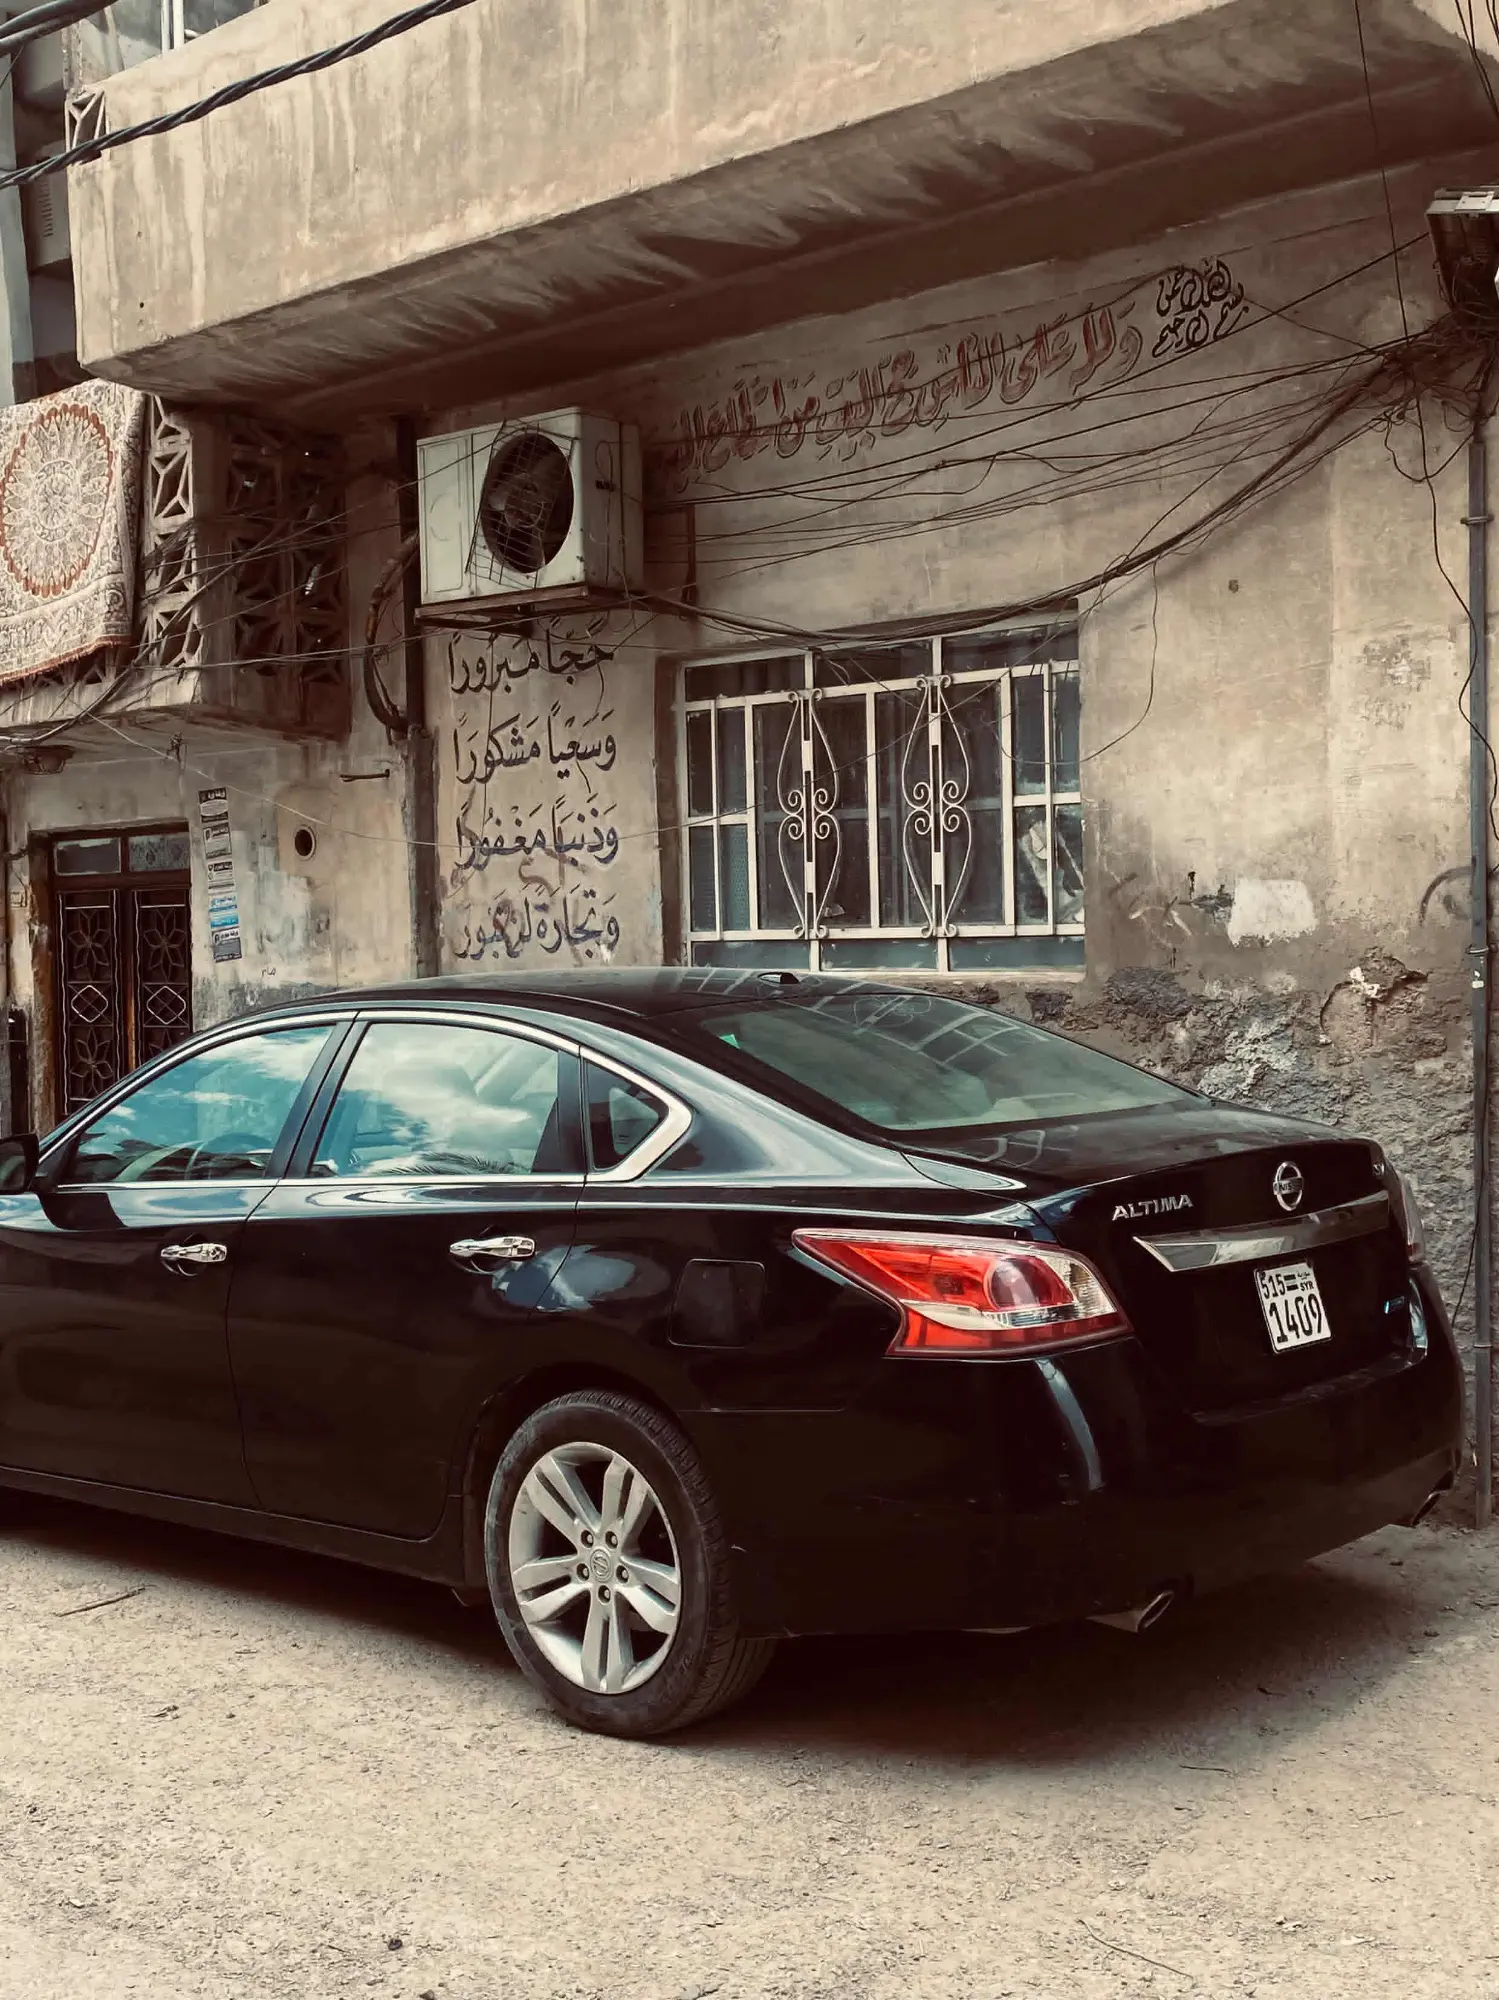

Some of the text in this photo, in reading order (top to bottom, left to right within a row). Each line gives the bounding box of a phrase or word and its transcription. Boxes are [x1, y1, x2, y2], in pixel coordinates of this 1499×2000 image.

[1111, 1194, 1194, 1221] ALTIMA
[1260, 1272, 1286, 1299] 515
[1300, 1281, 1314, 1291] SYR
[1269, 1294, 1321, 1343] 1409
